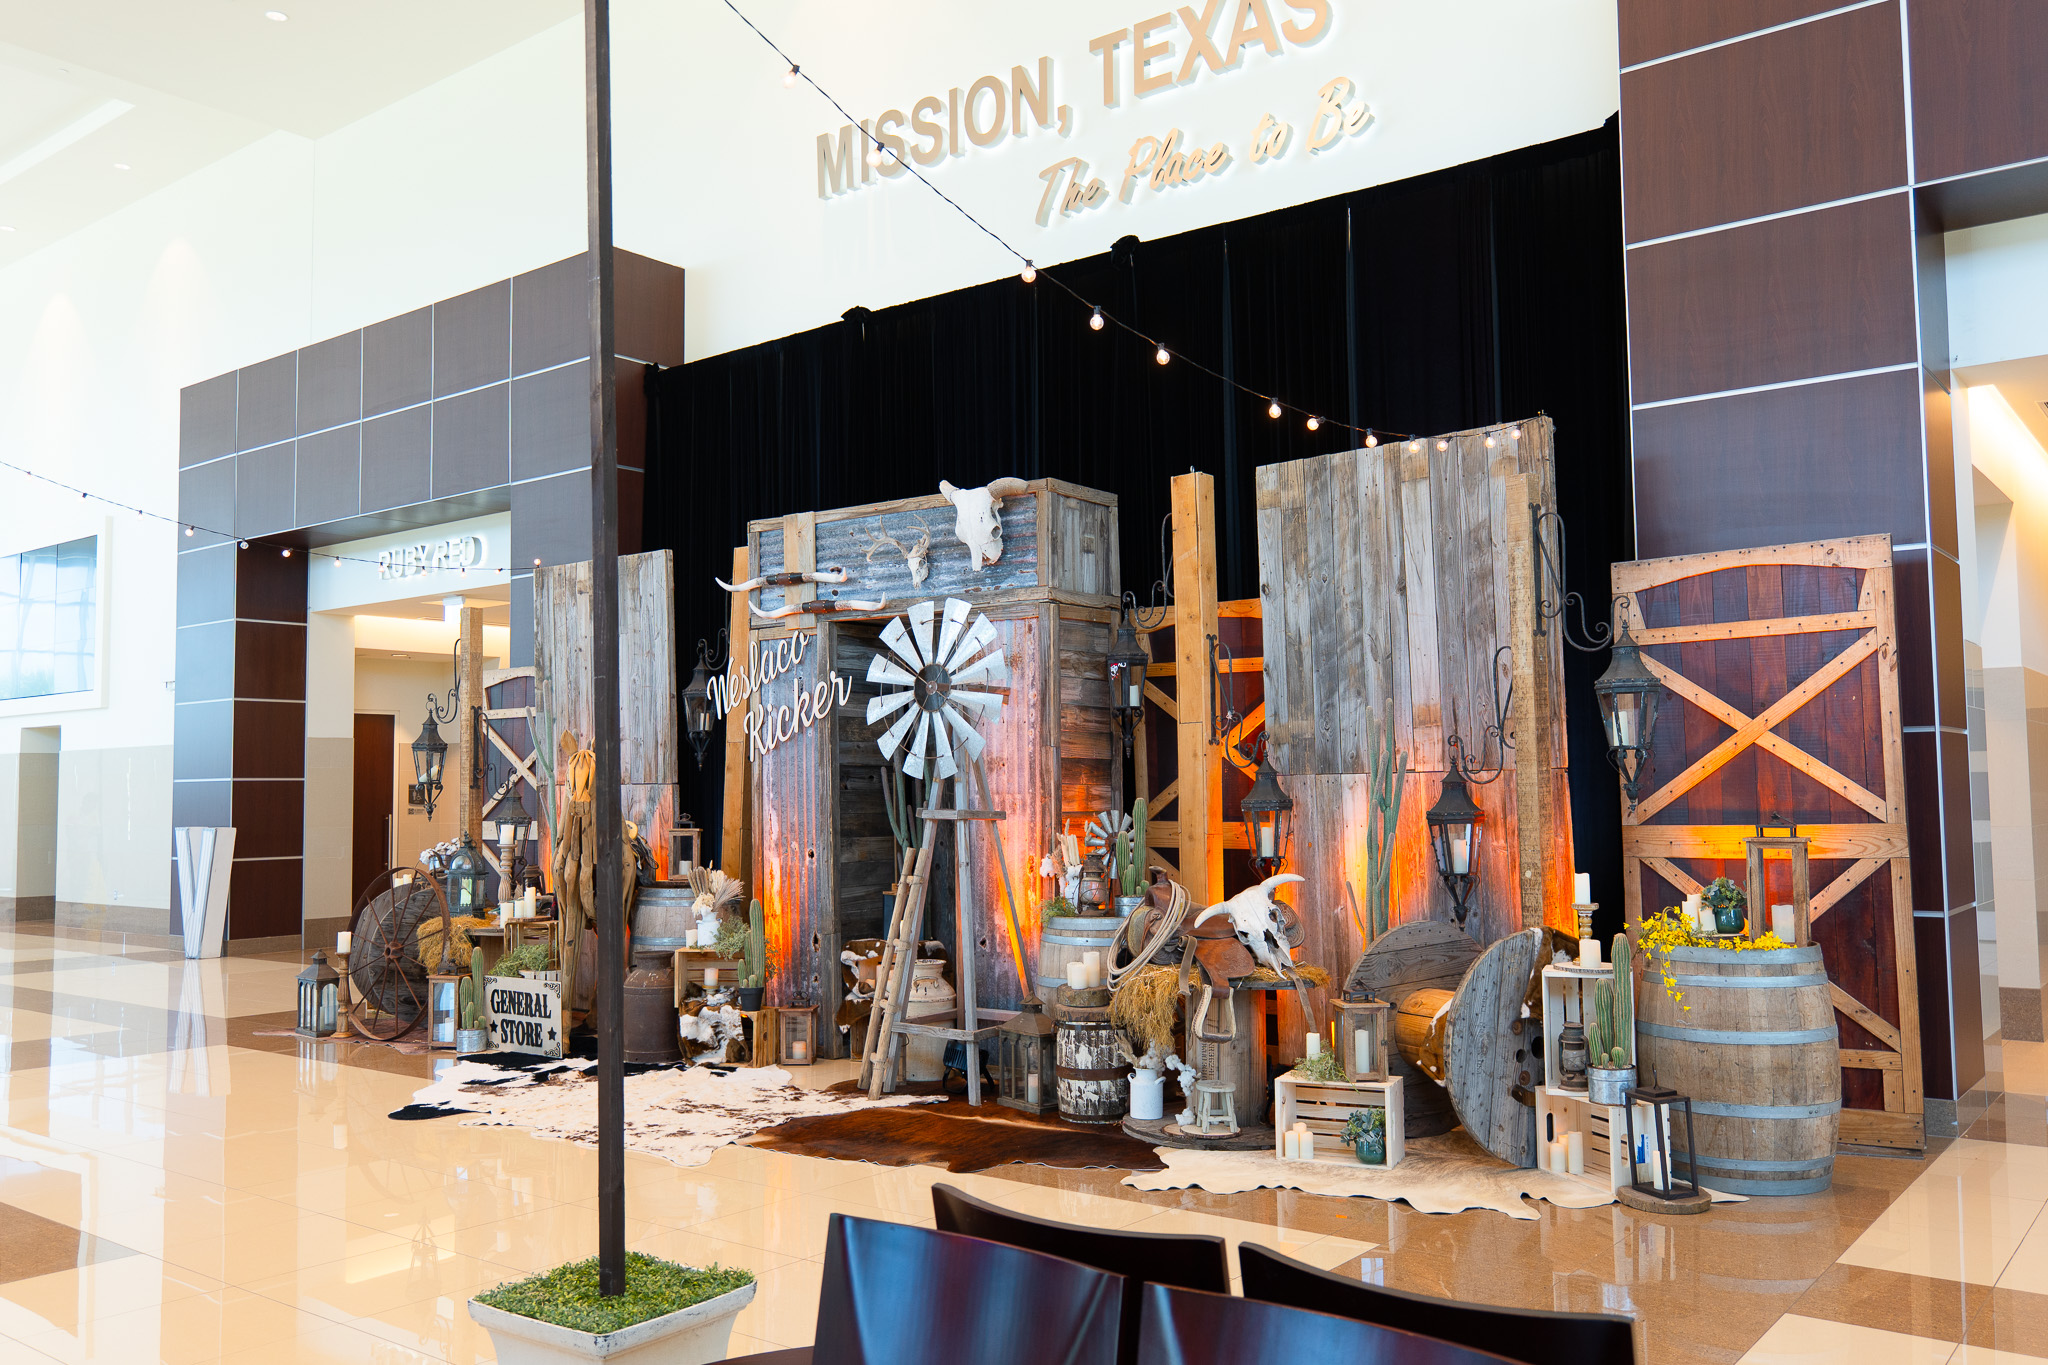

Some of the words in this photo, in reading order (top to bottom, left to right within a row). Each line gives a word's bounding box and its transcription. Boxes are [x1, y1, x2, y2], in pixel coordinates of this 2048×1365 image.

[816, 55, 1072, 200] MISSION,
[1036, 156, 1108, 227] The
[1119, 128, 1231, 204] Place
[1250, 112, 1293, 165] to
[1306, 76, 1374, 155] Be
[379, 545, 432, 580] RUBY
[432, 536, 482, 568] RED
[707, 630, 810, 720] Weslaco
[743, 670, 853, 762] Kicker
[490, 988, 552, 1019] GENERAL
[500, 1018, 543, 1048] STORE
